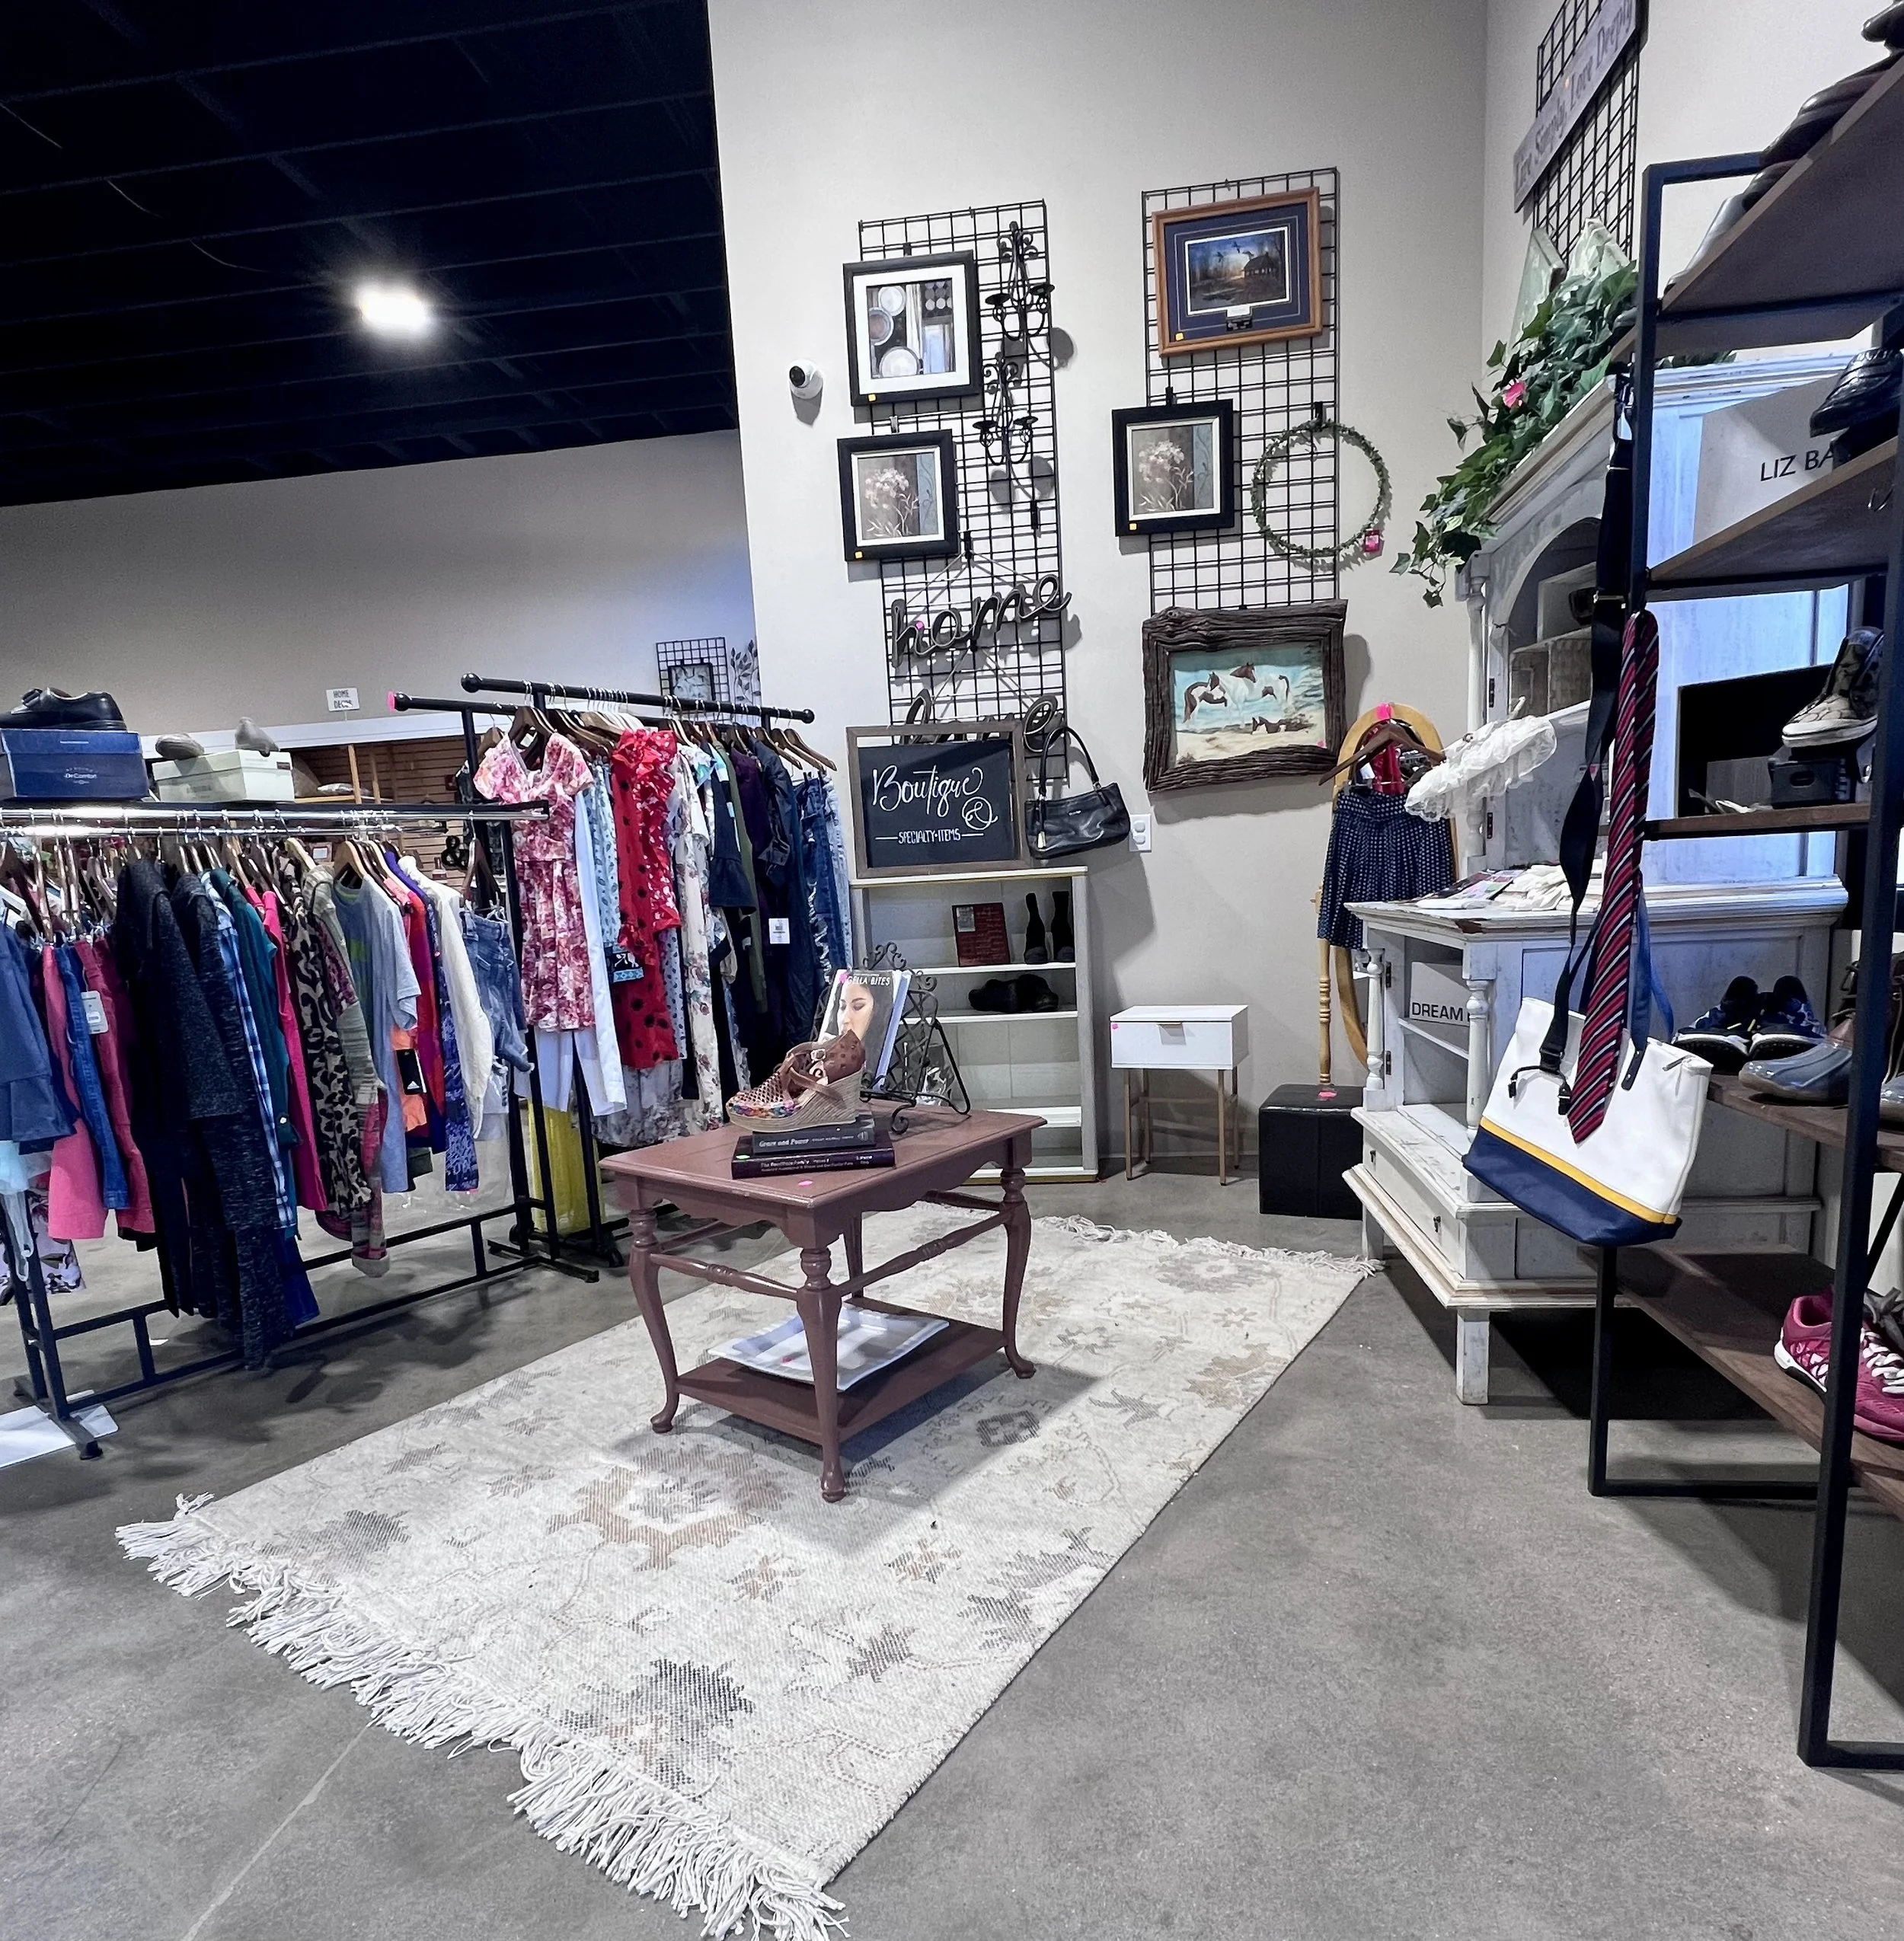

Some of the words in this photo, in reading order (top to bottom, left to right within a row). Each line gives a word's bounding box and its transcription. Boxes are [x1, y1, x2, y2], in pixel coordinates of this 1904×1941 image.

[1570, 56, 1593, 110] Love
[1761, 455, 1797, 481] LIZ
[1804, 442, 1834, 471] BA
[891, 574, 1072, 668] home
[333, 690, 350, 698] HOME
[873, 765, 983, 817] Boutique
[870, 976, 890, 986] BITES
[1412, 1002, 1463, 1022] DREAM
